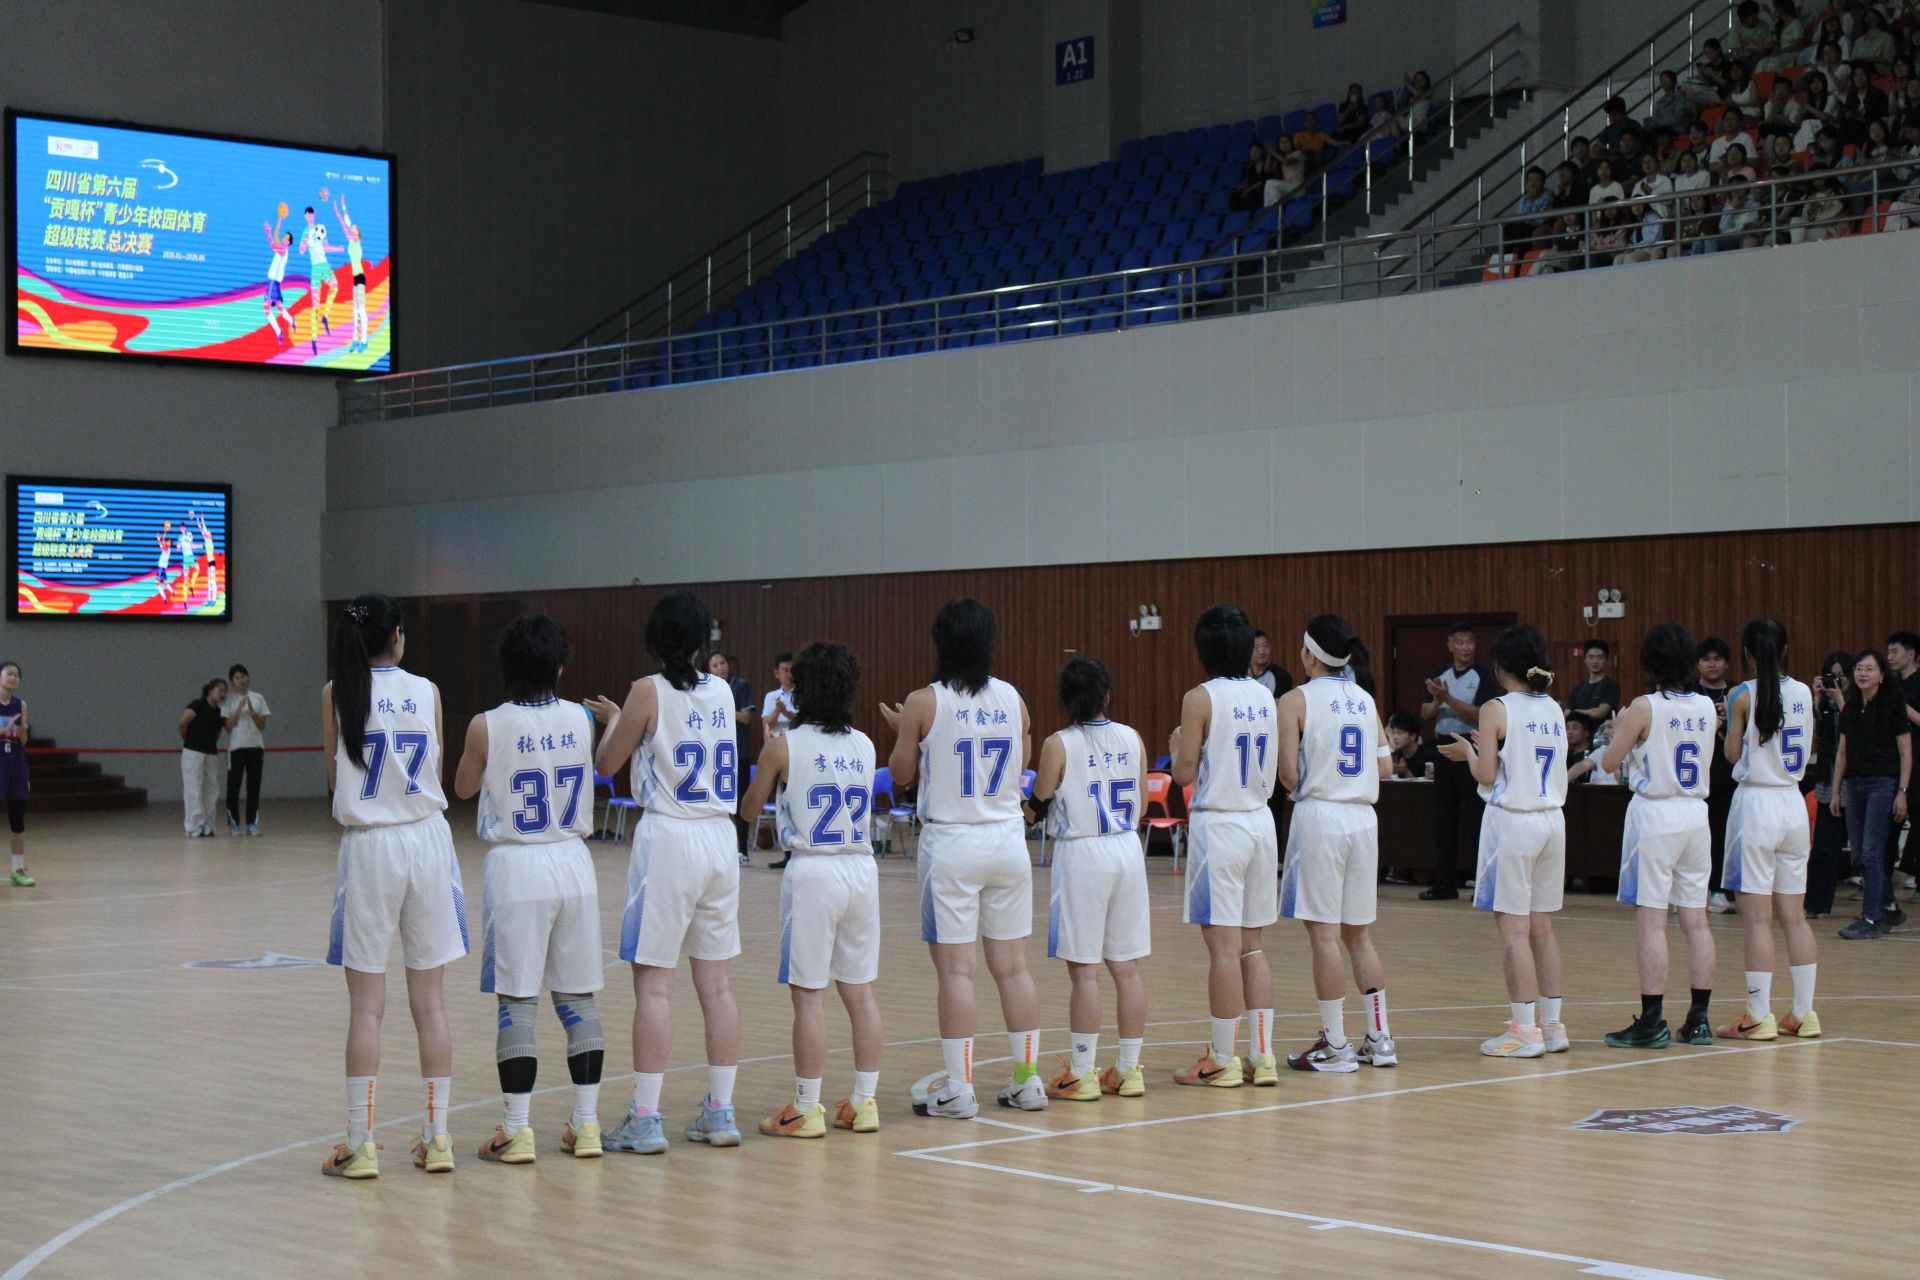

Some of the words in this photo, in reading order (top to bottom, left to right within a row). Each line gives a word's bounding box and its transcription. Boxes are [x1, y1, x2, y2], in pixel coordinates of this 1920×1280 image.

[1062, 41, 1088, 68] A1
[45, 169, 138, 200] 四川省第六届
[685, 708, 727, 730] 冉玥
[955, 707, 1008, 725] 何鑫融
[1526, 720, 1562, 737] 甘佳鑫
[360, 729, 429, 801] 77
[517, 731, 577, 754] 张佳琪
[815, 753, 864, 774] 李林楠
[954, 737, 1012, 798] 17
[1235, 733, 1268, 788] 11
[1337, 724, 1364, 777] 9
[1674, 741, 1701, 790] 6
[1780, 726, 1804, 775] 5
[673, 740, 737, 804] 28
[1535, 746, 1556, 797] 7
[510, 763, 585, 835] 37
[807, 782, 869, 847] 22
[1087, 778, 1136, 837] 15
